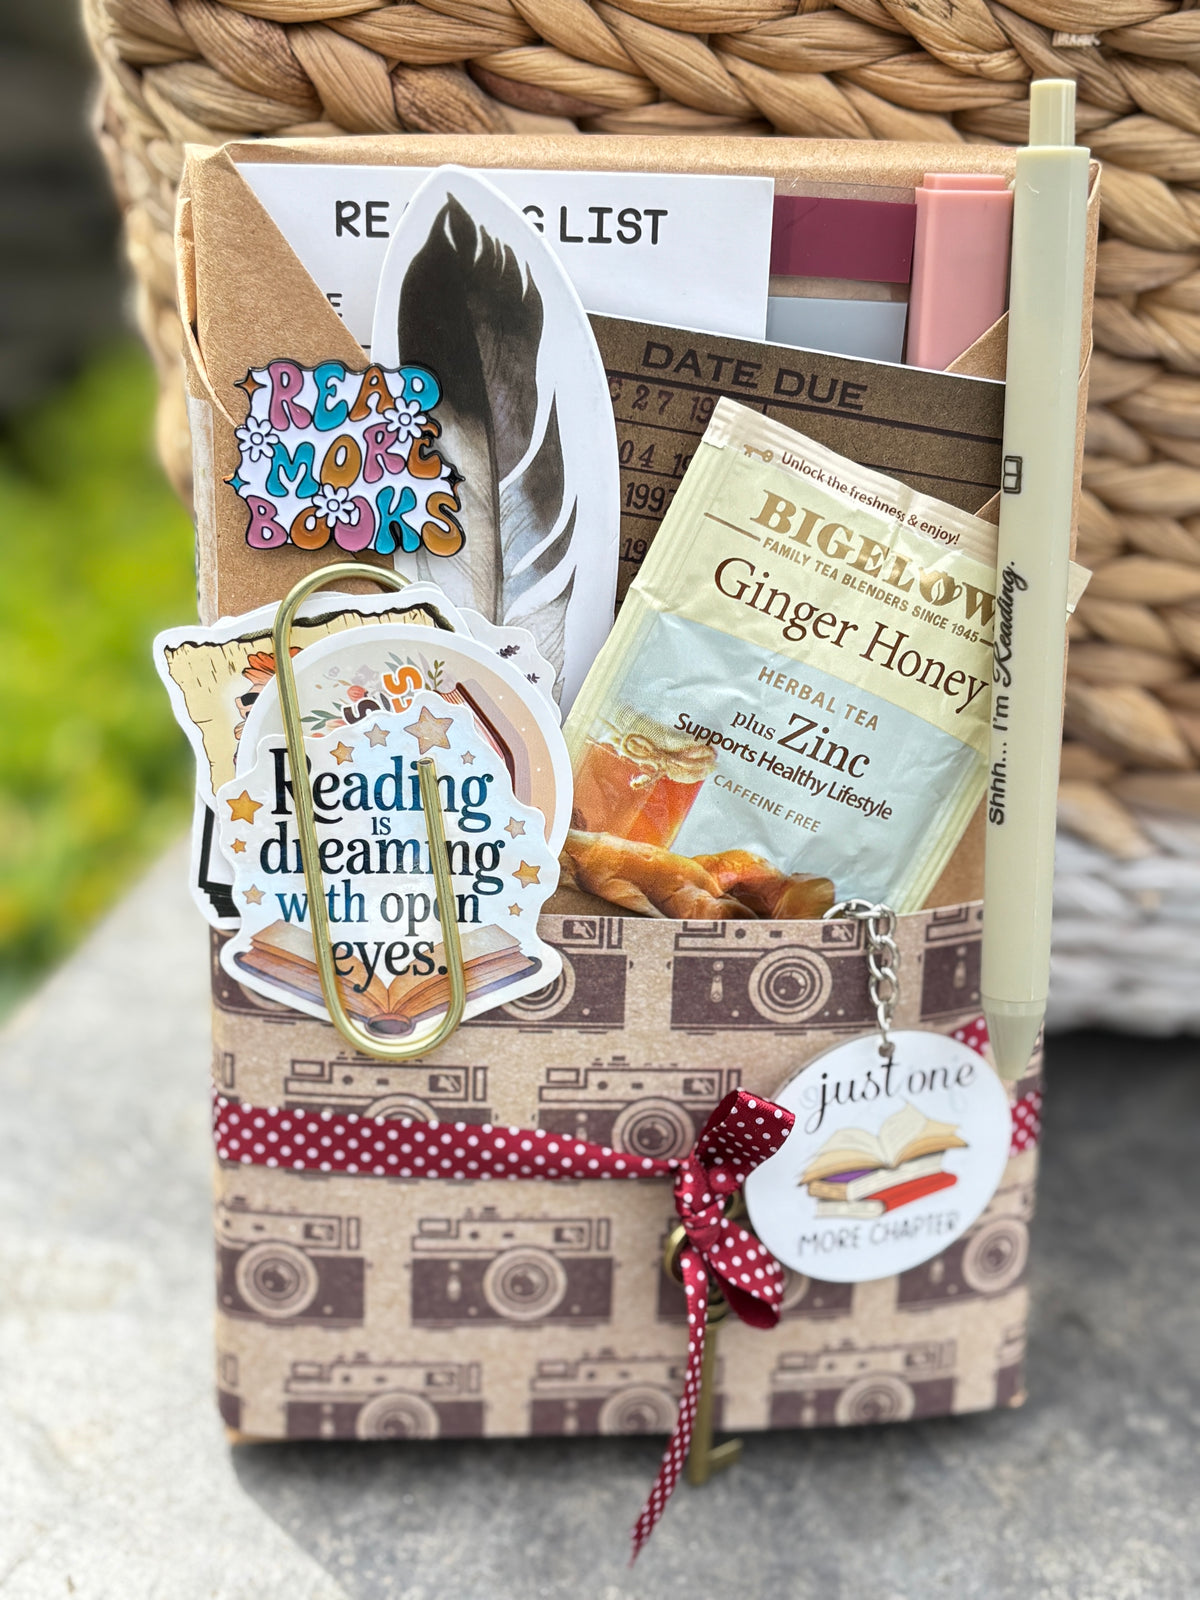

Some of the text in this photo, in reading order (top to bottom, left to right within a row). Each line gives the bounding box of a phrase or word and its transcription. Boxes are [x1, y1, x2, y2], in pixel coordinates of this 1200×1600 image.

[560, 205, 668, 245] LIST
[268, 361, 443, 431] READ
[631, 384, 674, 415] 27
[690, 396, 715, 424] 19
[642, 341, 869, 411] DATE DUE
[266, 419, 442, 499] MORE
[246, 486, 465, 557] BOOKS
[781, 451, 961, 545] Unlock the freshness & enjoy!
[624, 537, 648, 562] 19
[750, 489, 996, 627] BIGELOW
[762, 537, 979, 644] FAMILY TEA BLENDERS SINCE 1945
[992, 561, 1028, 688] Reading.
[714, 556, 989, 715] Ginger Honey
[757, 666, 880, 731] HERBAL TEA
[993, 695, 1009, 731] I'm
[674, 712, 893, 820] Supports Healthy Lifestyle
[730, 710, 870, 778] plus Zinc
[269, 748, 494, 833] Reading
[371, 816, 392, 835] is
[713, 774, 821, 833] CAFFEINE FREE
[275, 879, 368, 923] wth
[332, 940, 449, 994] eyes.
[805, 1056, 976, 1134] just one
[798, 1211, 960, 1256] MORE CHAPTER
